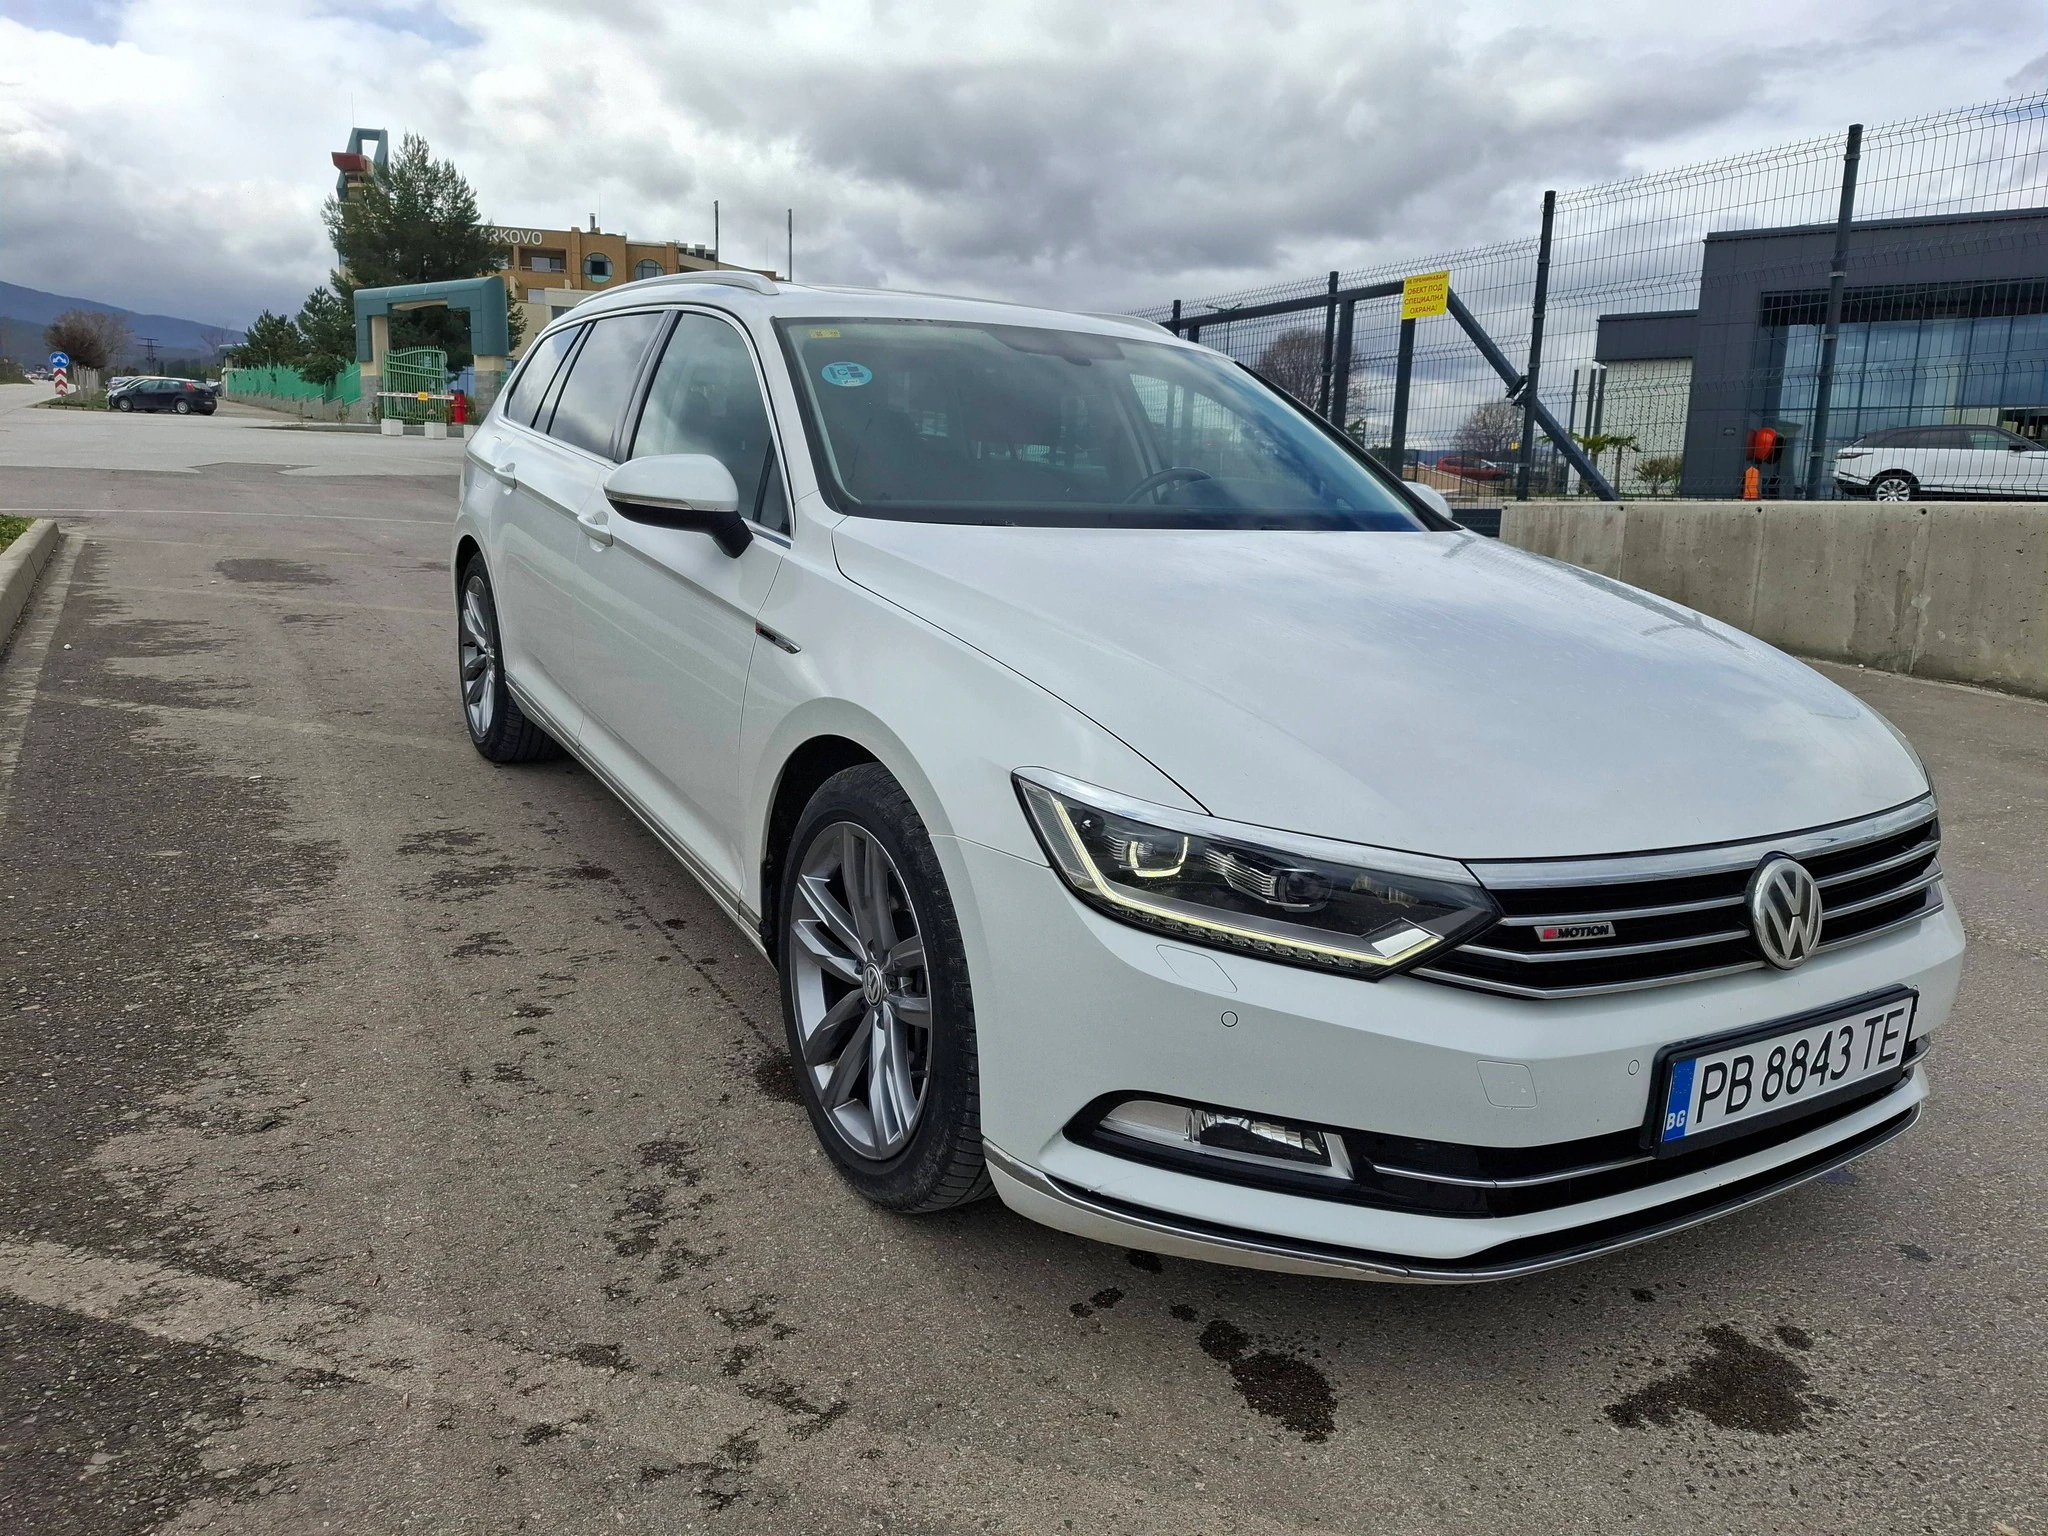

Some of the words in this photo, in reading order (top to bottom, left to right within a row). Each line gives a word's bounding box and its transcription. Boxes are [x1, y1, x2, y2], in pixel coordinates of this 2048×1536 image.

[1407, 285, 1428, 295] ОБЕКТ
[1428, 283, 1443, 292] ПОД
[1404, 294, 1444, 305] СПЕЦИАЛНА
[1761, 1025, 1854, 1103] 8843
[1666, 1109, 1686, 1131] BG
